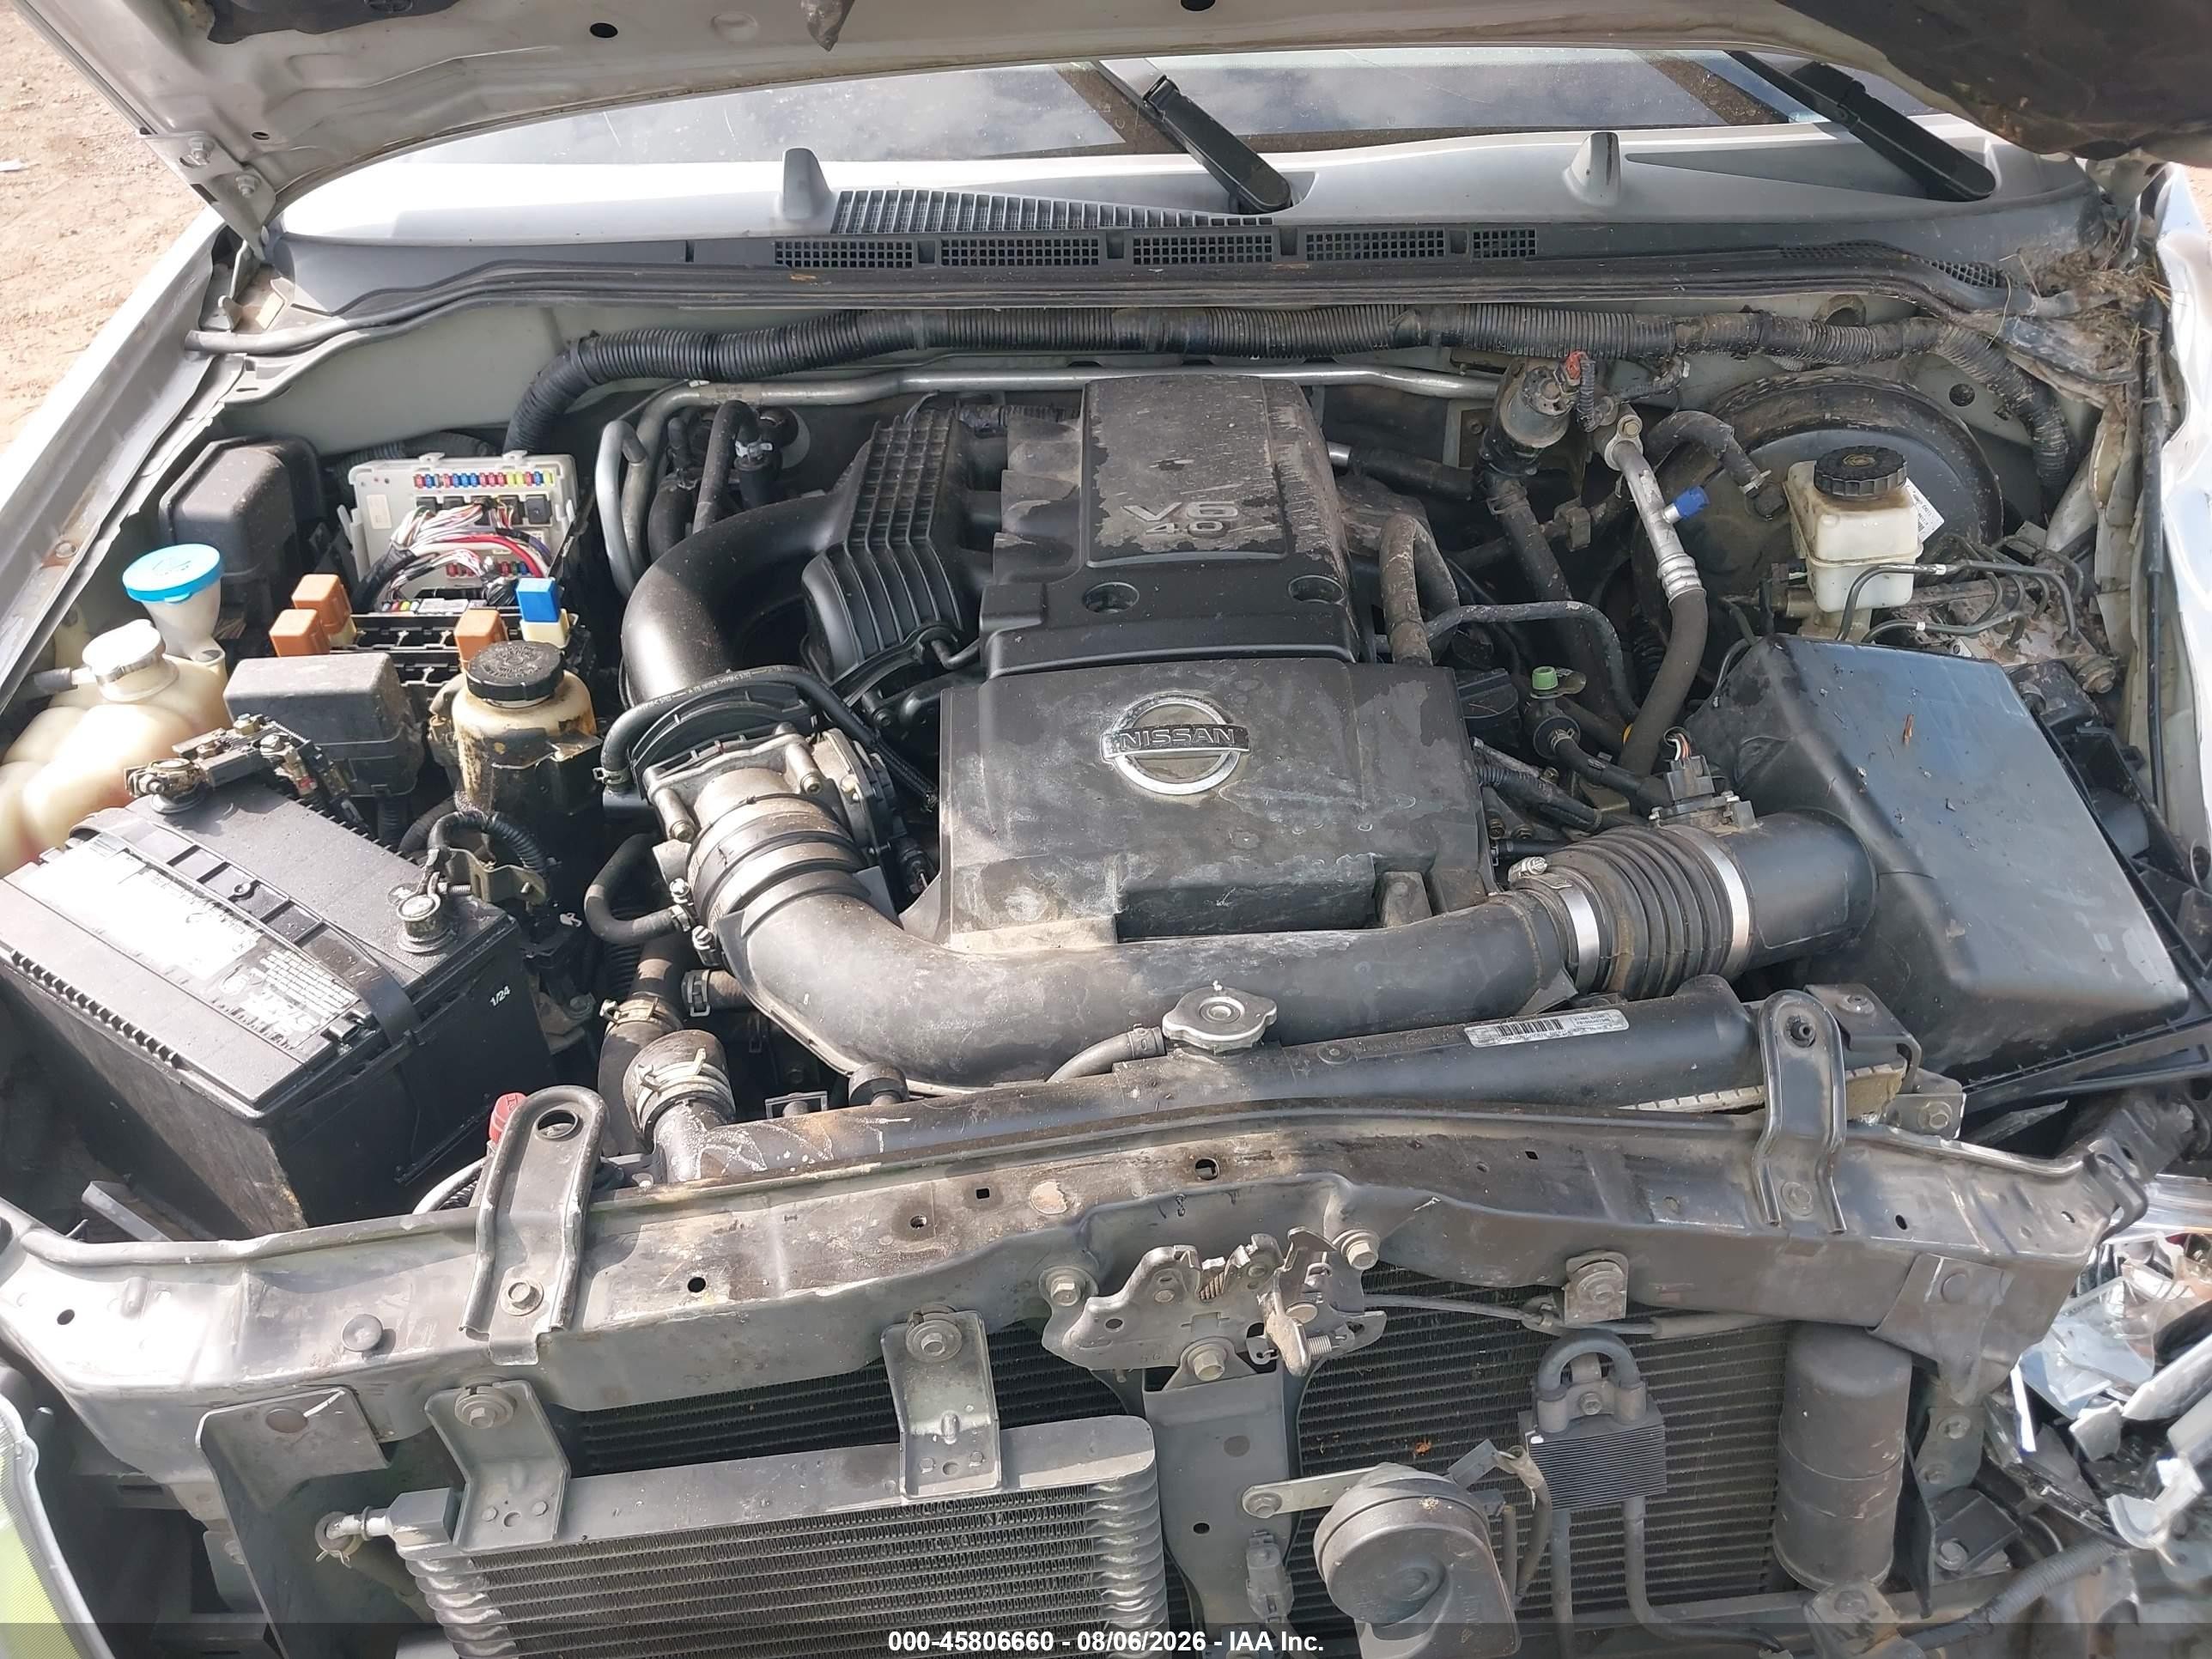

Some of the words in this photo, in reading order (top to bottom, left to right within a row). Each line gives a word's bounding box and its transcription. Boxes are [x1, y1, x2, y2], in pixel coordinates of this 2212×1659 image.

[1120, 501, 1238, 522] V6
[1119, 727, 1236, 751] NISSAN
[489, 985, 511, 1006] 1/24
